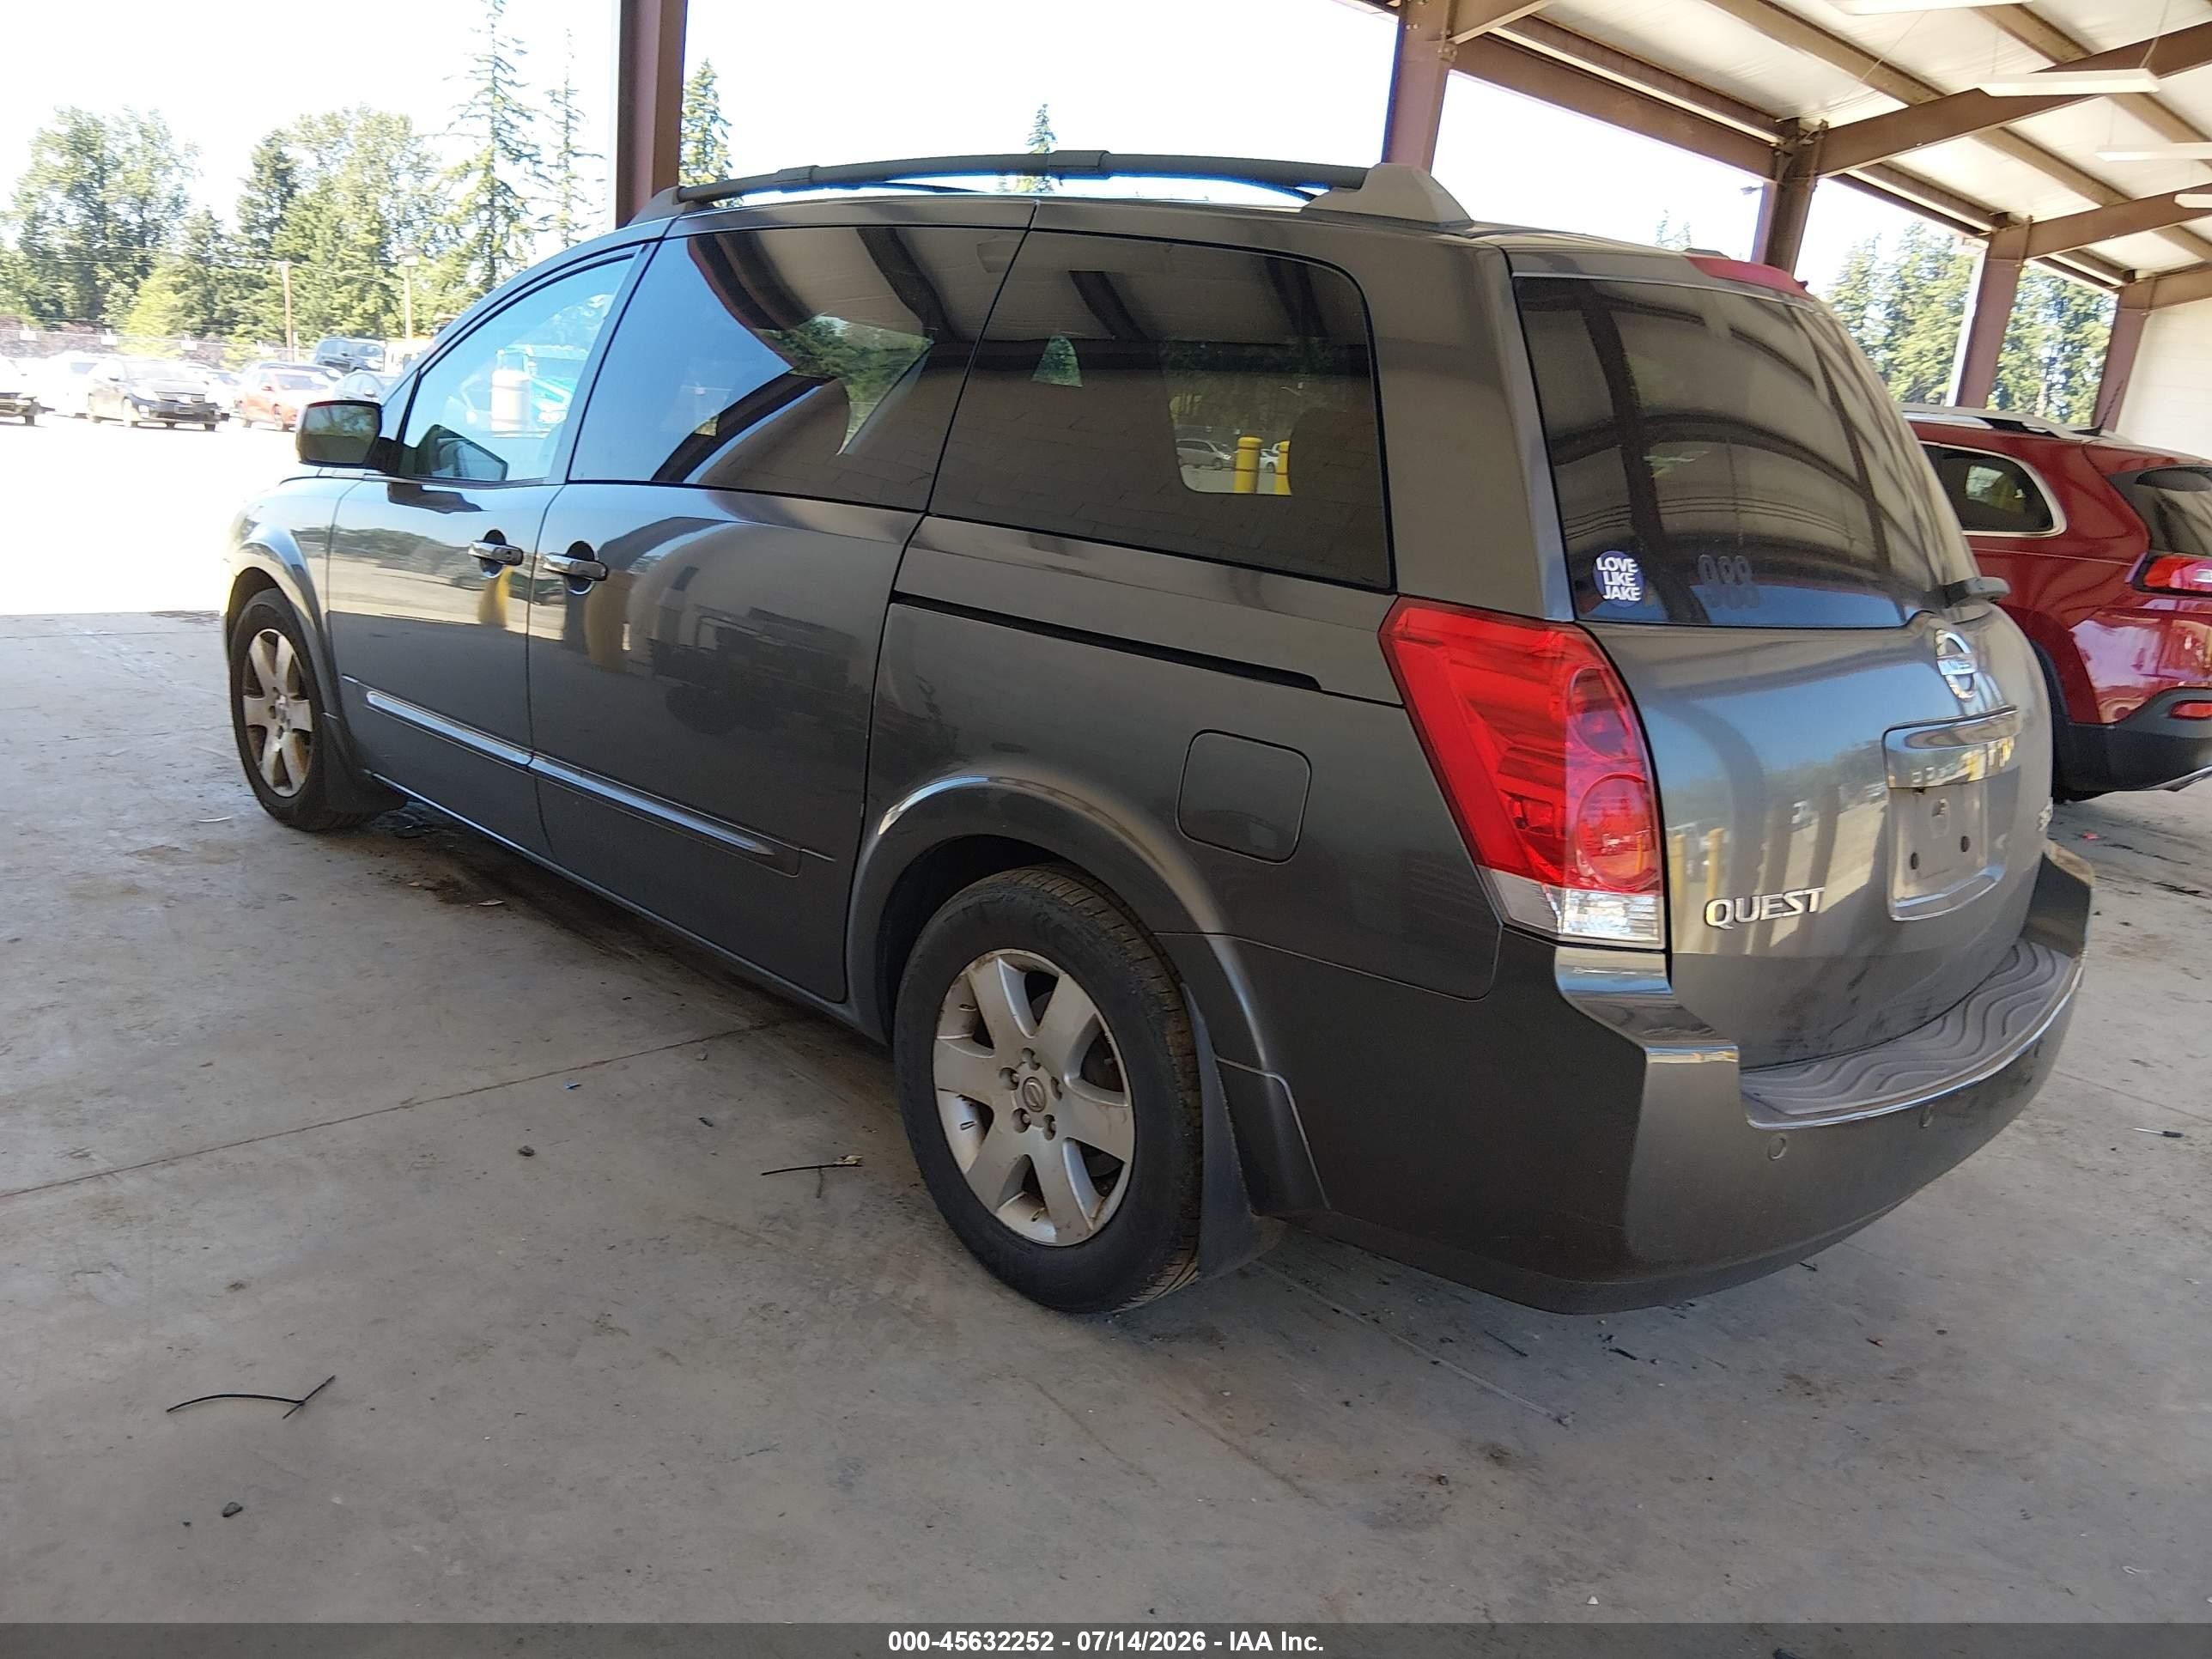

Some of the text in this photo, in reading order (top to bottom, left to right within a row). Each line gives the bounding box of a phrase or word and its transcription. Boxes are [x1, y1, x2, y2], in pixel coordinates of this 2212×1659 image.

[1595, 556, 1638, 573] LOVE
[1602, 571, 1636, 586] LIKE
[1602, 586, 1642, 601] JAKE
[1705, 886, 1826, 930] QUEST
